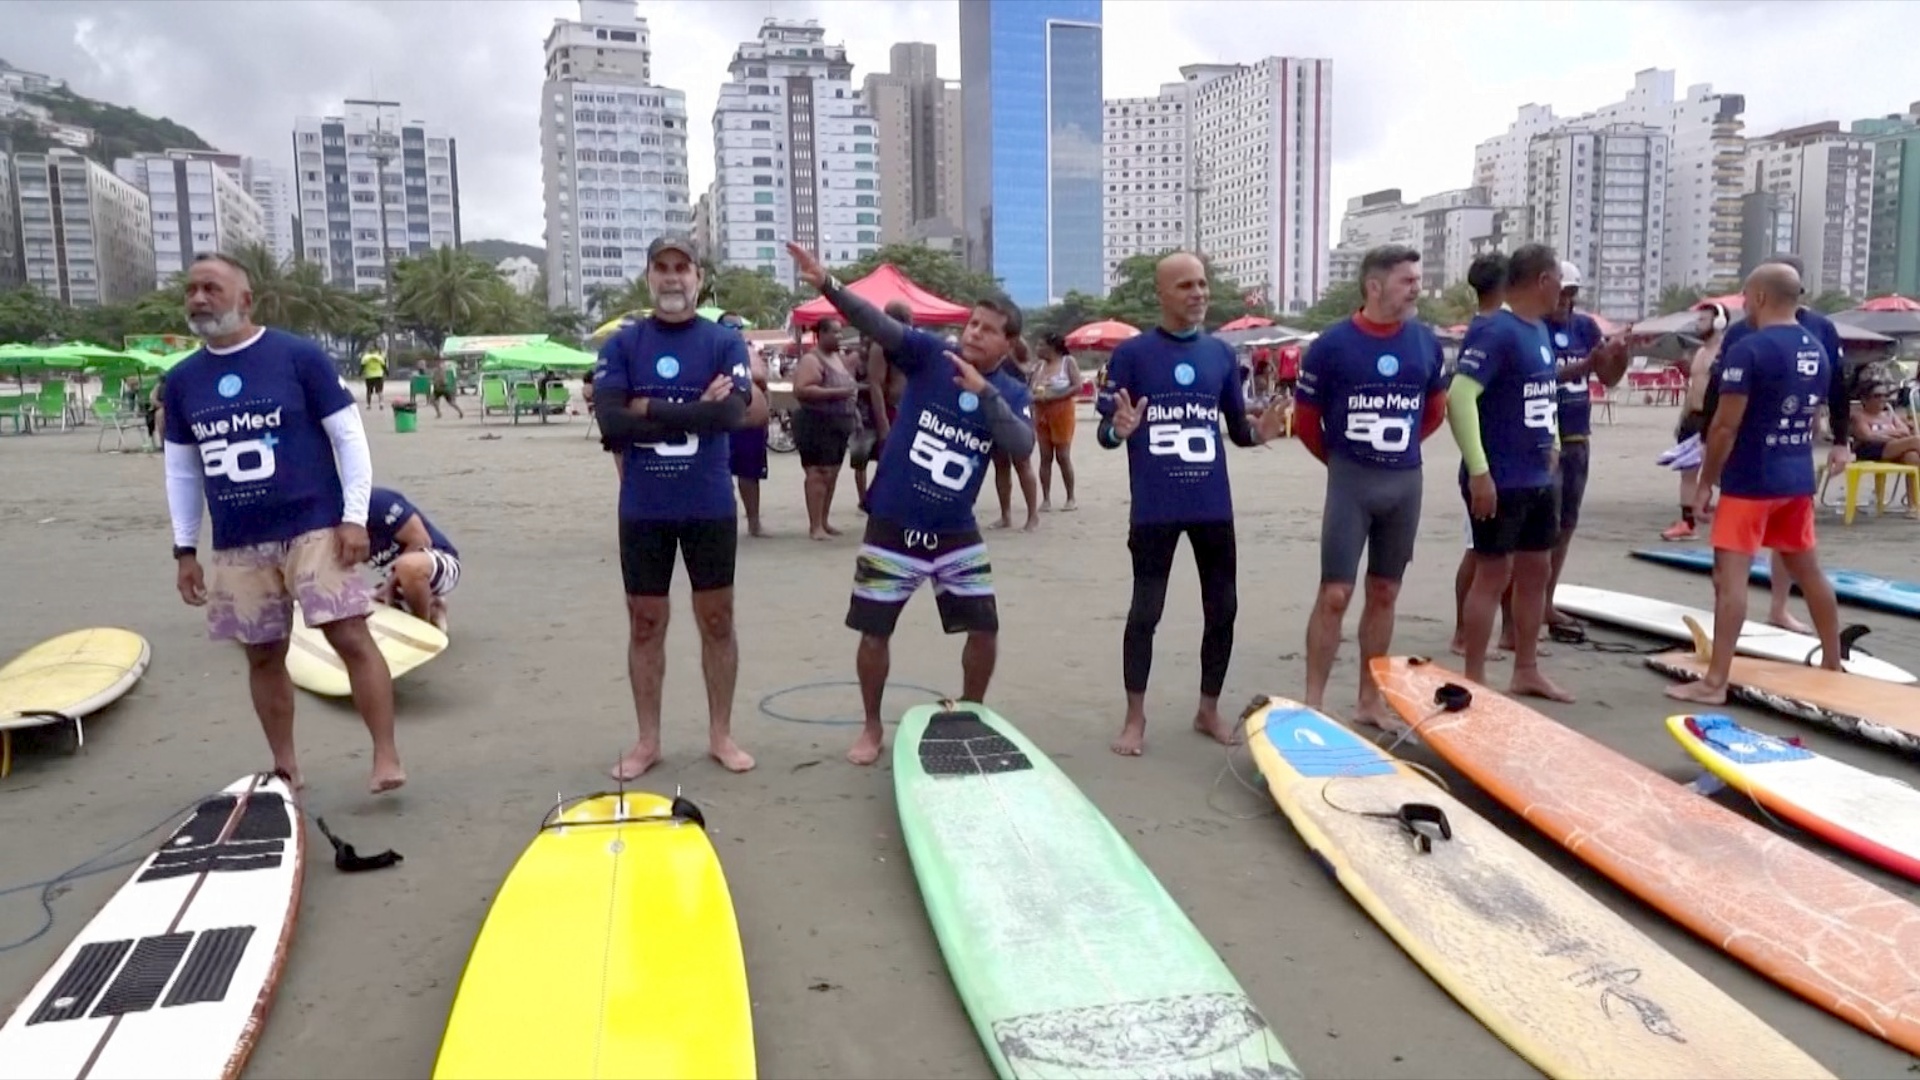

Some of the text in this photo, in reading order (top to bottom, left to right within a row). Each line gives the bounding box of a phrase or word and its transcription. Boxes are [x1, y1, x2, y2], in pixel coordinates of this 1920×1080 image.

[1348, 393, 1420, 410] Blue Med
[232, 405, 282, 432] Med
[1147, 402, 1218, 422] Blue Med
